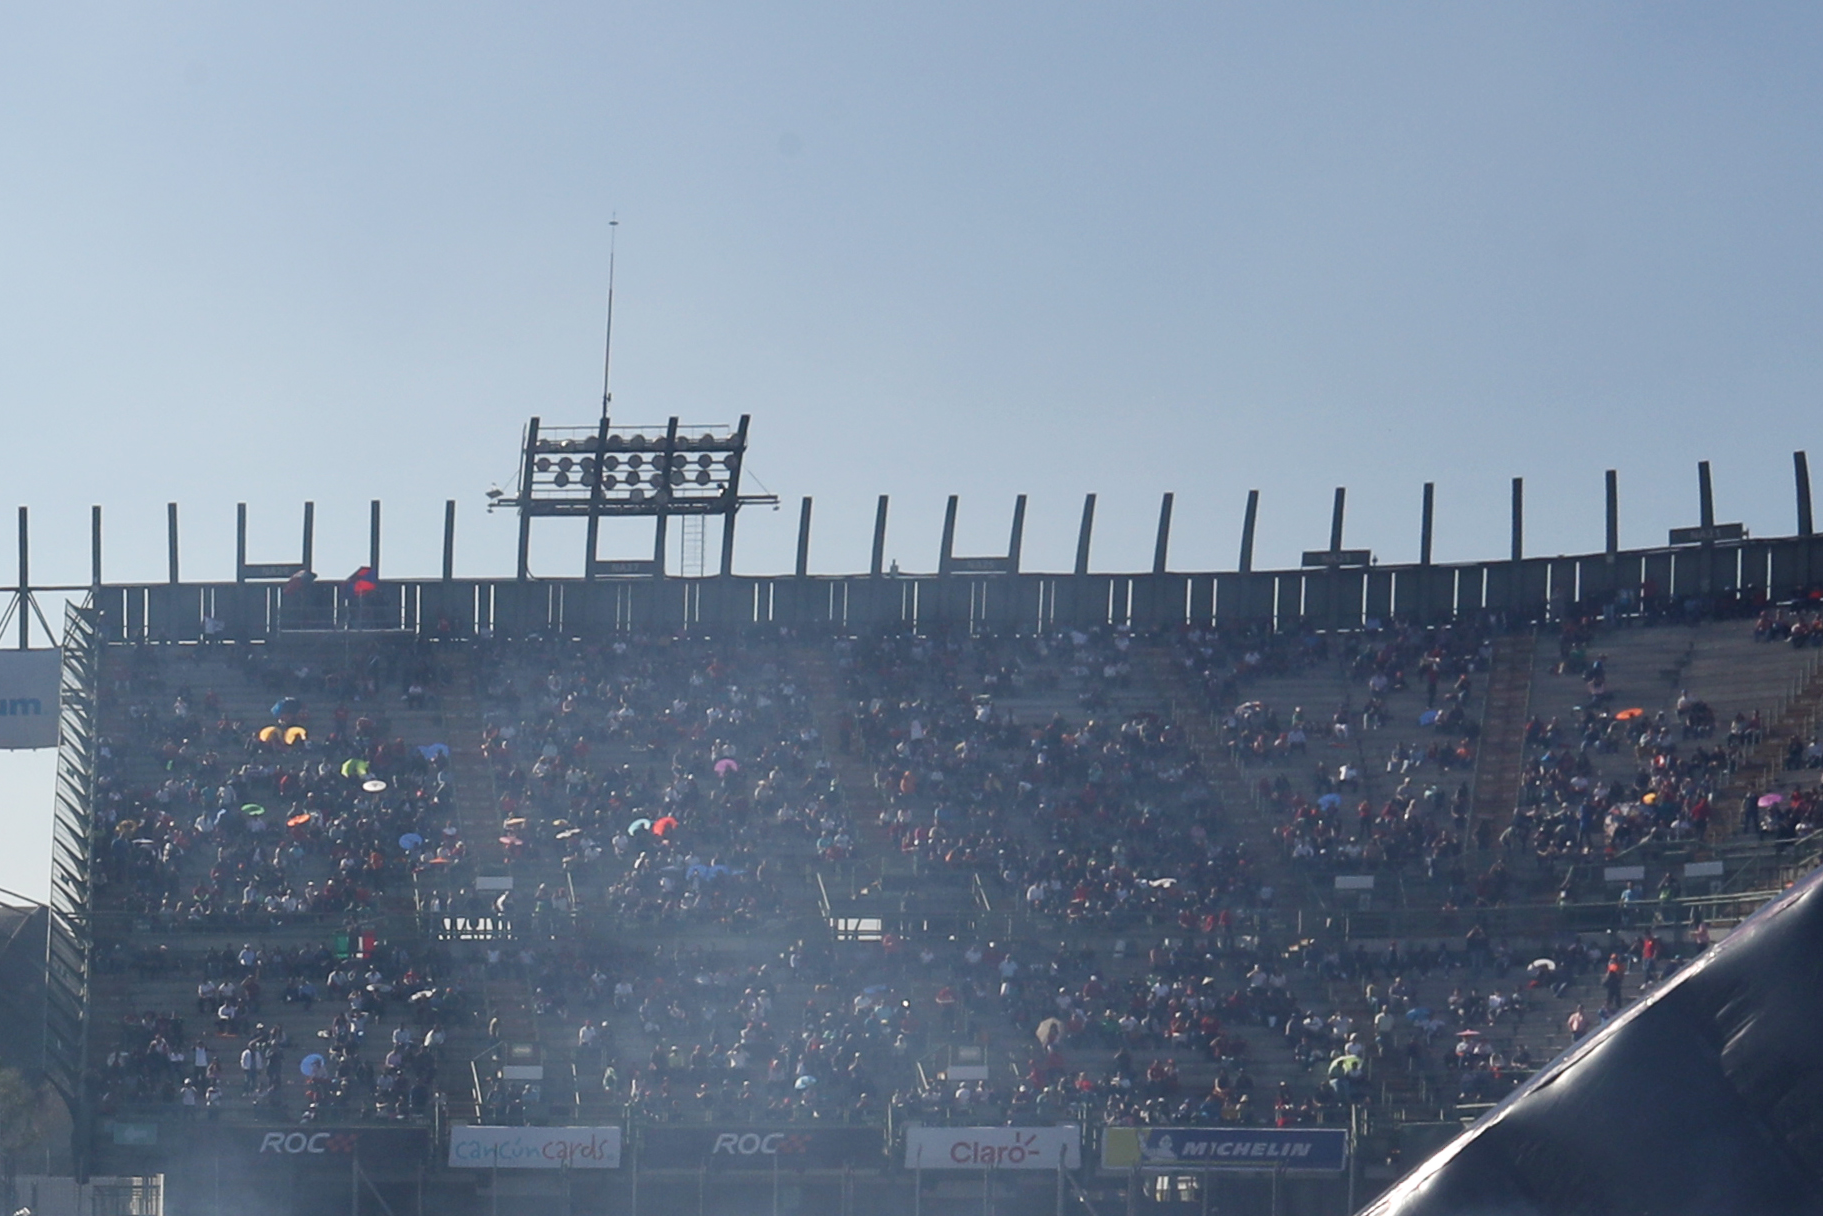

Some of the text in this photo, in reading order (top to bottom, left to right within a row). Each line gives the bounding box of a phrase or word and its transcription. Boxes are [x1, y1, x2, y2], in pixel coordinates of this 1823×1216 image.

[260, 1132, 330, 1154] ROC
[712, 1132, 784, 1155] ROC
[950, 1139, 1027, 1165] Claro
[1181, 1141, 1313, 1157] MICHELIN
